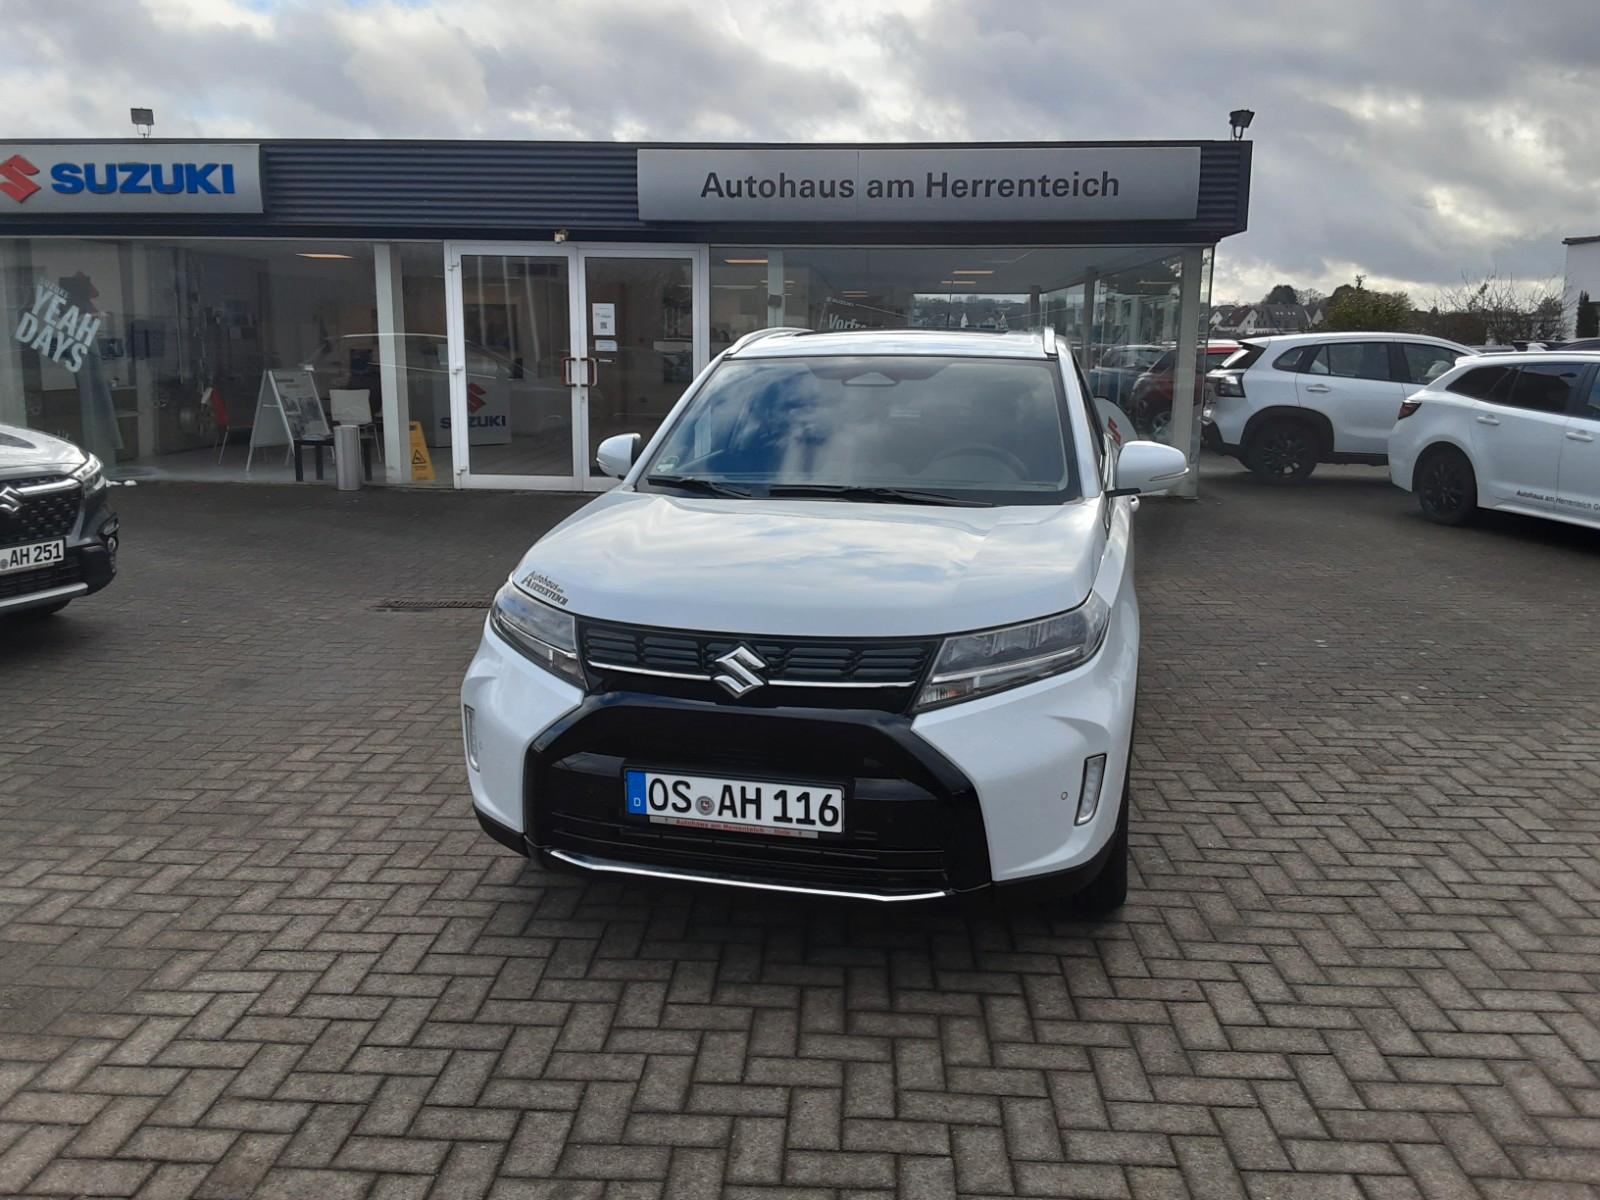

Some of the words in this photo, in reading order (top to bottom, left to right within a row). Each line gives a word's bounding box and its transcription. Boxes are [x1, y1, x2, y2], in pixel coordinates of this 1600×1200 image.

[50, 163, 235, 194] SUZUKI
[701, 172, 855, 198] Autohaus
[867, 177, 914, 197] am
[926, 171, 1120, 197] Herrenteich
[32, 284, 101, 347] YEAH
[15, 312, 88, 373] DAYS
[440, 416, 506, 429] SZUKI
[10, 548, 30, 567] AH
[33, 542, 62, 563] 251
[633, 797, 641, 807] D
[649, 778, 692, 813] OS
[718, 784, 762, 820] AH
[773, 789, 839, 827] 116
